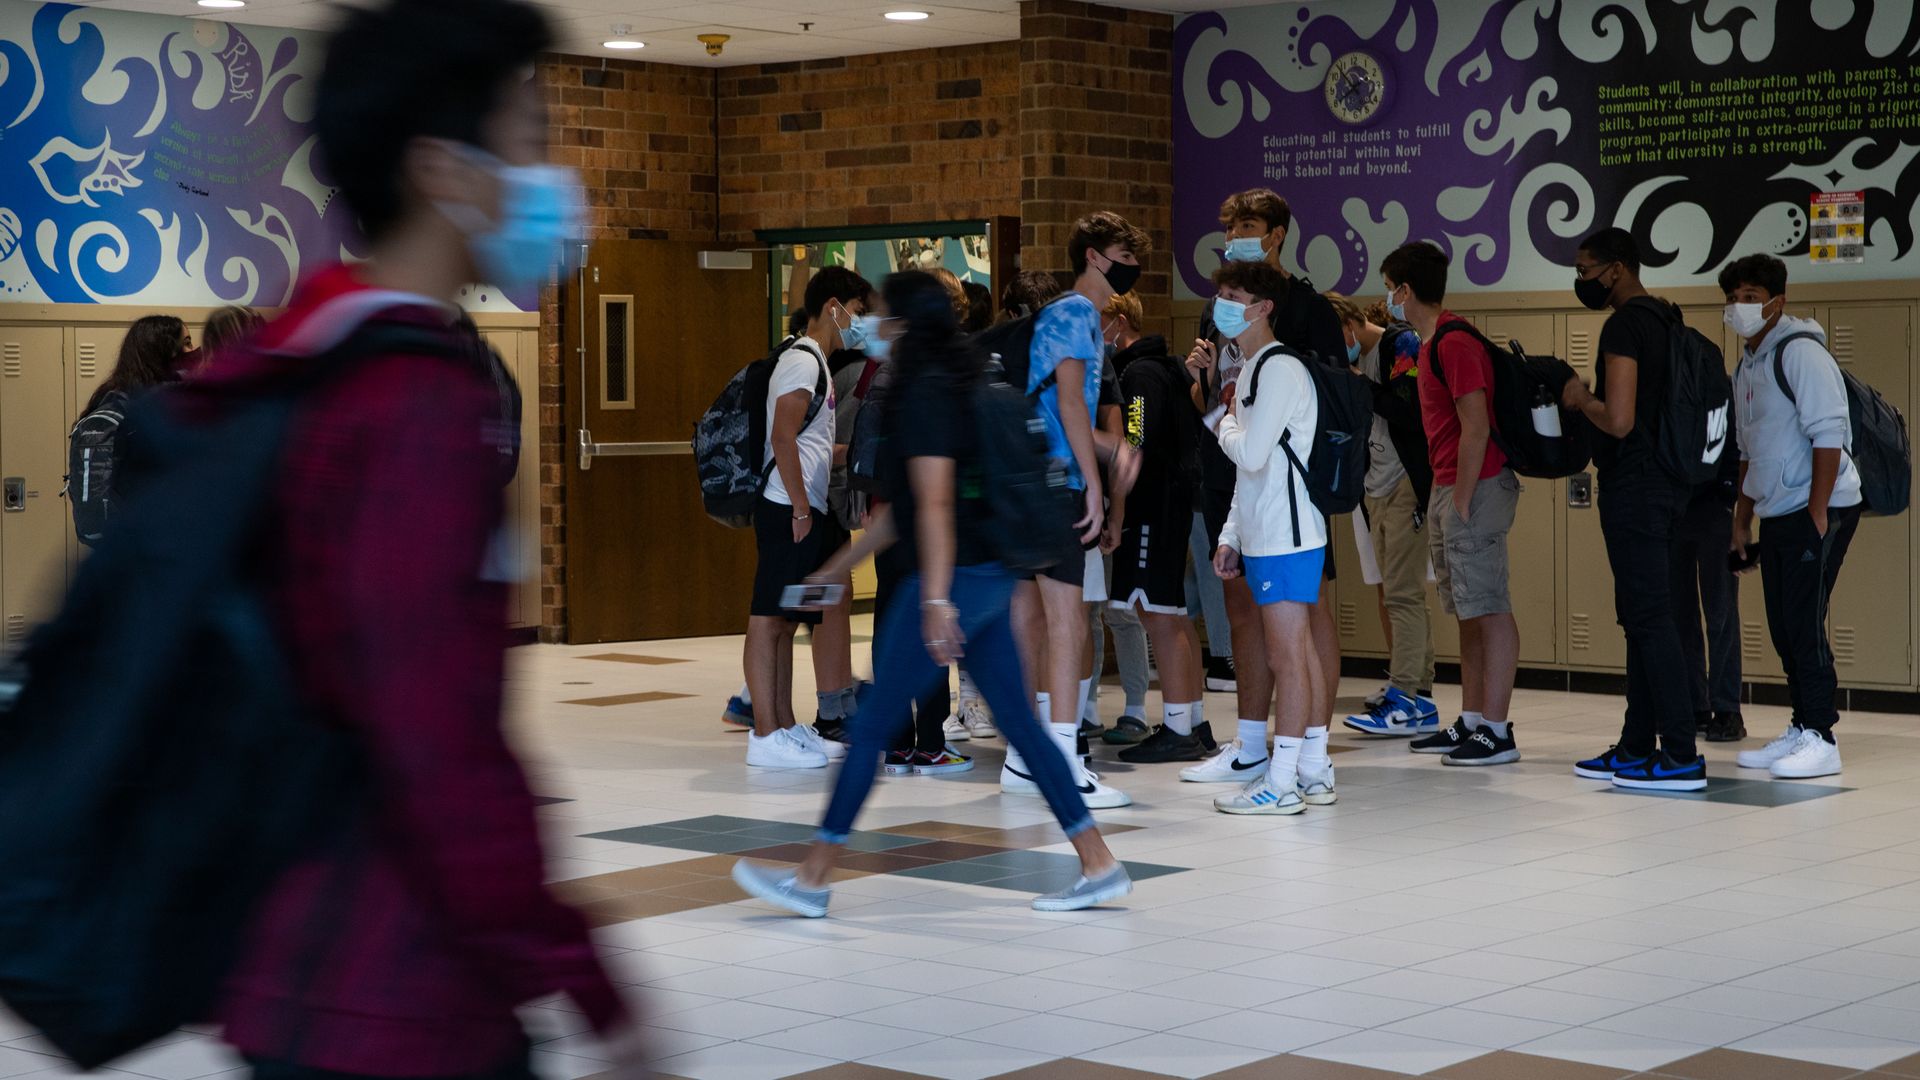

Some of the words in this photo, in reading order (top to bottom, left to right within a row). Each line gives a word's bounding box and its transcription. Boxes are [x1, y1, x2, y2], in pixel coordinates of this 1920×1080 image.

[1599, 84, 1650, 99] Students
[1659, 81, 1684, 96] will,
[1690, 81, 1702, 93] in
[1710, 76, 1798, 92] collaboration
[1807, 69, 1836, 85] with
[1846, 66, 1901, 85] parents,
[1599, 99, 1671, 114] community:
[1675, 93, 1755, 110] demonstrate
[1762, 88, 1823, 105] integrity,
[1827, 83, 1877, 100] develop
[1883, 81, 1908, 96] 21st
[1600, 116, 1634, 132] skills,
[1639, 114, 1685, 128] become
[1692, 107, 1790, 123] self-advocates,
[1795, 104, 1842, 118] engage
[1849, 102, 1861, 114] in
[1868, 103, 1875, 113] a
[1263, 135, 1316, 148] Educating
[1322, 131, 1335, 144] all
[1343, 129, 1391, 143] students
[1398, 128, 1409, 138] to
[1416, 123, 1450, 138] fulfill
[1600, 134, 1655, 151] program,
[1660, 126, 1731, 145] participate
[1737, 125, 1749, 136] in
[1757, 116, 1863, 136] extra-curricular
[1264, 150, 1290, 163] their
[1296, 147, 1346, 161] potential
[1356, 145, 1390, 159] within
[1396, 144, 1421, 157] Novi
[1600, 152, 1631, 166] know
[1636, 149, 1662, 162] that
[1667, 144, 1725, 160] diversity
[1733, 143, 1743, 155] is
[1749, 144, 1756, 153] a
[1762, 137, 1826, 155] strength.
[1264, 165, 1288, 180] High
[1295, 162, 1332, 177] School
[1339, 163, 1359, 176] and
[1366, 160, 1411, 176] beyond.
